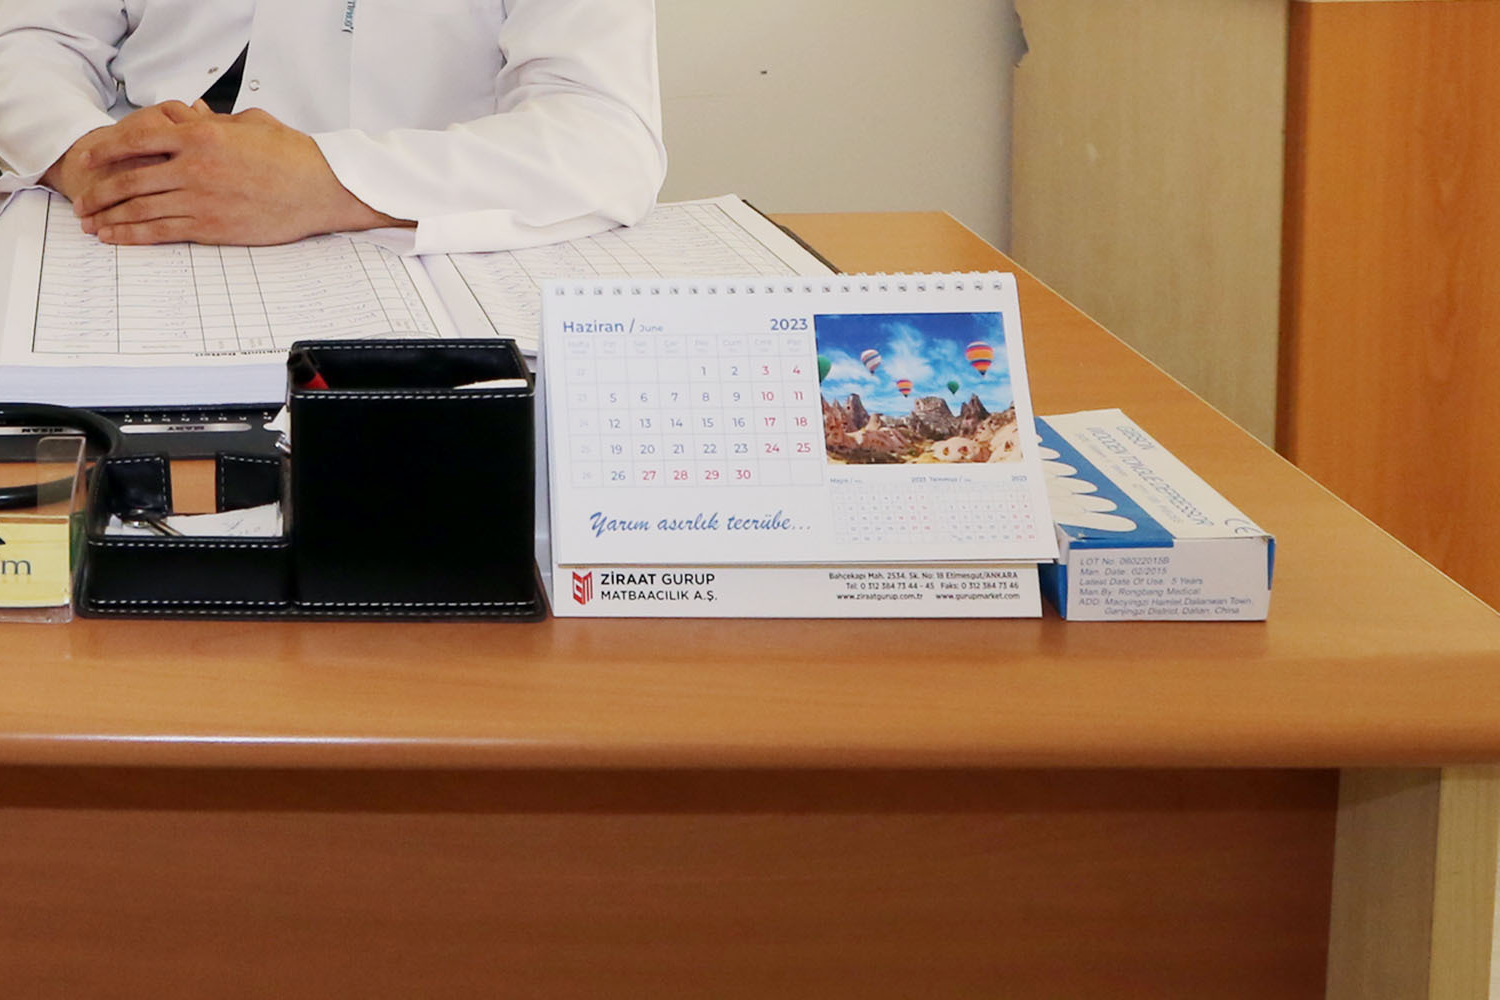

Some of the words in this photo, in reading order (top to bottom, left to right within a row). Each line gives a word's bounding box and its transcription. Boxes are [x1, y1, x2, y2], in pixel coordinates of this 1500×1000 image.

[563, 319, 624, 333] Haziran
[770, 318, 808, 331] 2023
[701, 366, 706, 376] 1
[731, 366, 738, 376] 2
[762, 366, 770, 375] 3
[792, 365, 801, 375] 4
[610, 392, 617, 403] 5
[640, 392, 648, 402] 6
[671, 392, 678, 402] 7
[702, 392, 710, 402] 8
[733, 392, 741, 401] 9
[761, 391, 774, 401] 10
[794, 391, 804, 401] 11
[609, 418, 621, 429] 12
[640, 418, 652, 429] 13
[670, 418, 683, 428] 14
[702, 418, 714, 428] 15
[732, 418, 746, 428] 16
[764, 417, 776, 427] 17
[795, 417, 808, 427] 18
[610, 445, 623, 455] 19
[640, 444, 655, 455] 20
[673, 444, 685, 454] 21
[703, 444, 717, 454] 22
[734, 444, 748, 454] 23
[765, 443, 780, 453] 24
[796, 443, 811, 453] 25
[611, 471, 626, 481] 26
[642, 471, 657, 481] 27
[673, 470, 689, 481] 28
[704, 470, 719, 480] 29
[736, 470, 751, 480] 30
[589, 511, 651, 538] Yarım
[657, 512, 720, 531] asırlık
[1080, 557, 1099, 566] LOT
[600, 571, 657, 585] ZİRAAT
[662, 573, 715, 585] GURUP
[828, 572, 866, 580] Bahçekapı
[946, 571, 1018, 580] Etimesgut/ANKARA
[868, 582, 880, 590] 312
[897, 582, 906, 590] 73
[969, 582, 980, 590] 312
[1109, 577, 1130, 586] Date
[1180, 577, 1203, 585] Years
[601, 590, 690, 601] MATBAACILIK
[694, 590, 718, 603] A.Ş.
[1167, 587, 1201, 596] Medical
[836, 593, 923, 601] www.ziraatgurup.com.tr
[935, 593, 1020, 601] www.gurupmarket.com
[1214, 606, 1240, 615] China
